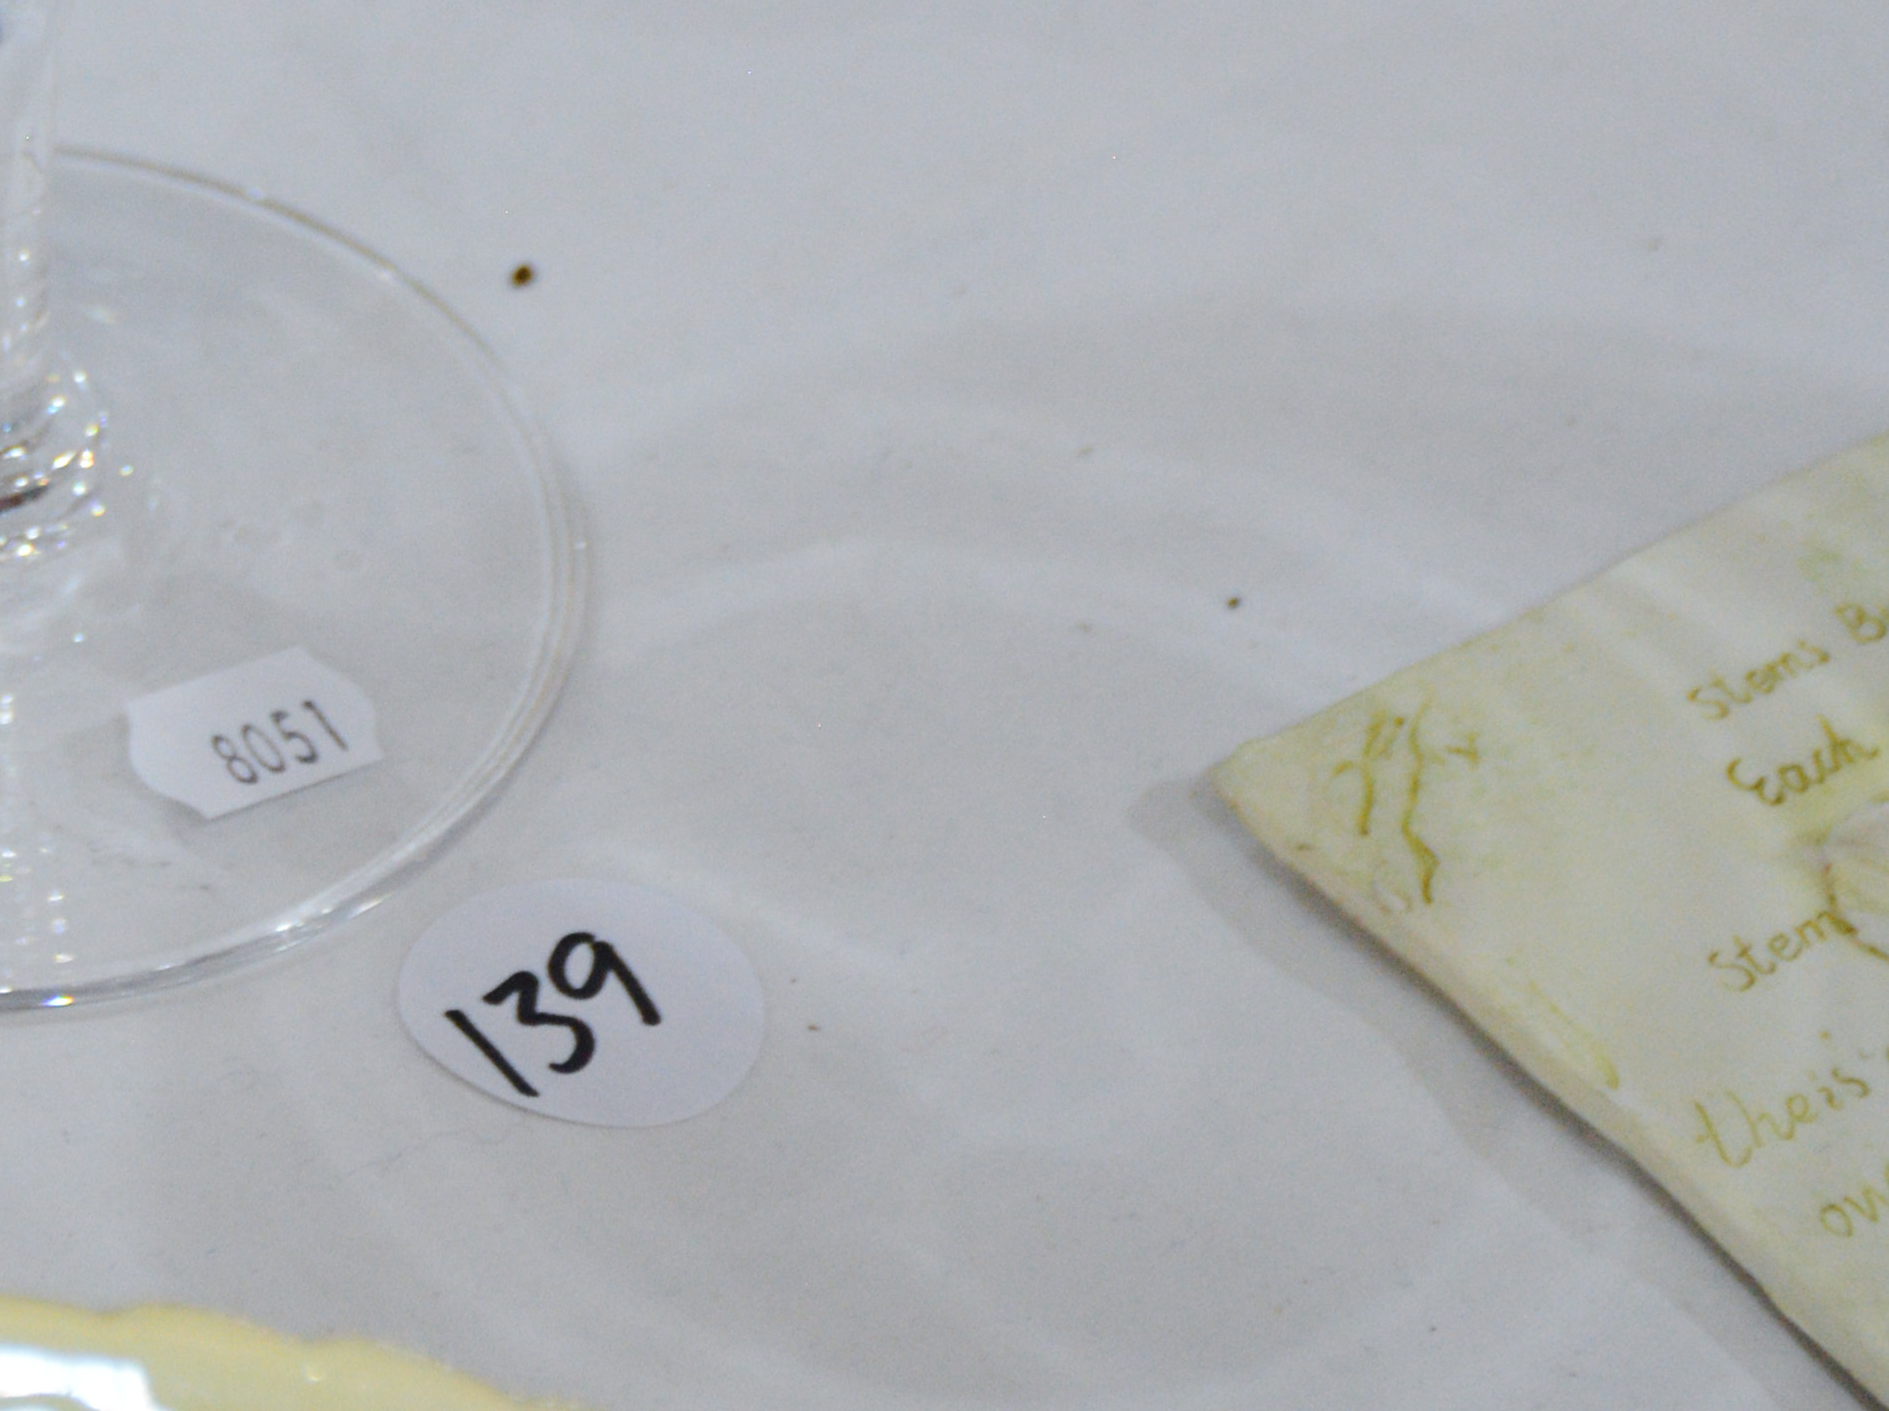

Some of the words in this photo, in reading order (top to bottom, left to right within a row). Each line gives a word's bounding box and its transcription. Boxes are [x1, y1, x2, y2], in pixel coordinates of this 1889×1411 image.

[211, 699, 349, 785] 8051
[1725, 712, 1880, 807] Each
[443, 931, 663, 1098] 139
